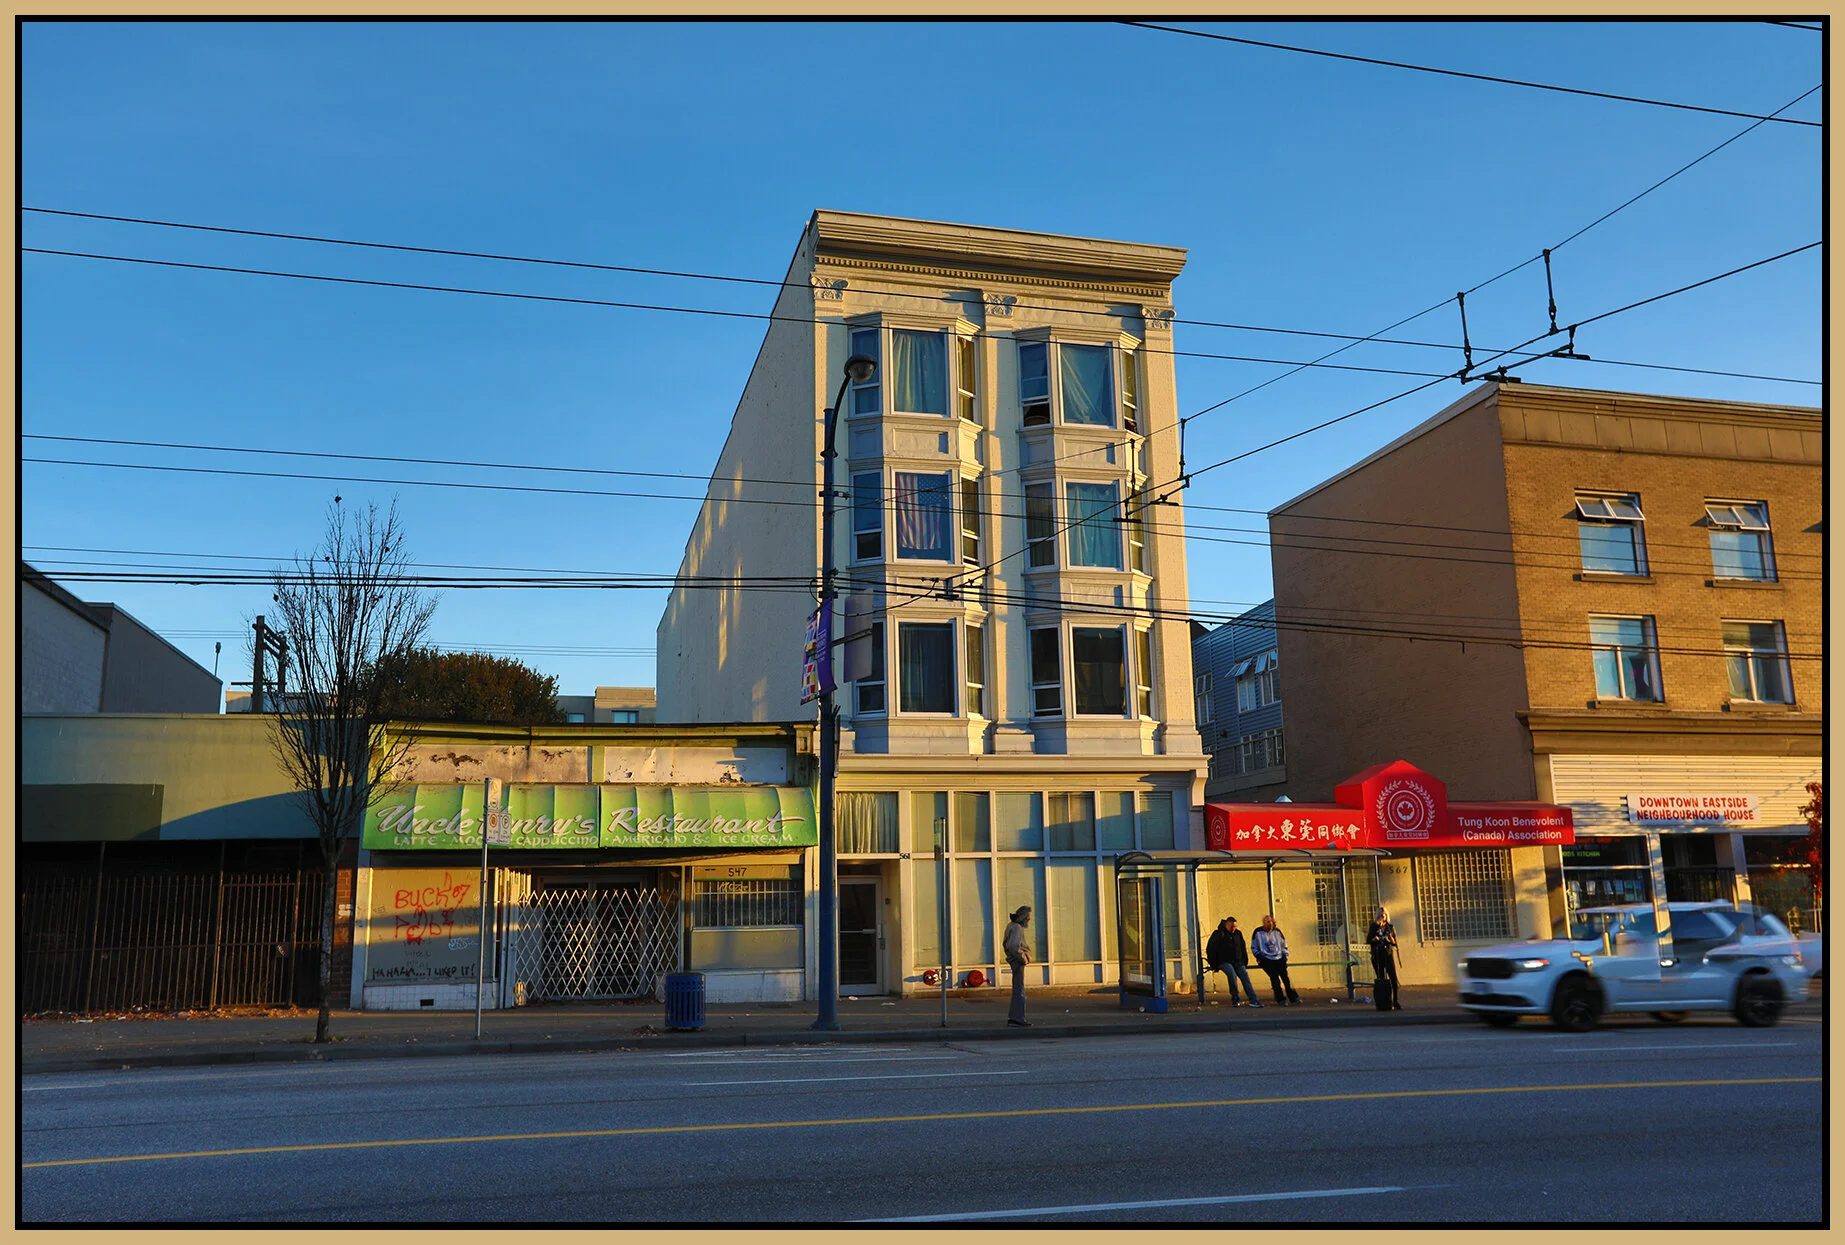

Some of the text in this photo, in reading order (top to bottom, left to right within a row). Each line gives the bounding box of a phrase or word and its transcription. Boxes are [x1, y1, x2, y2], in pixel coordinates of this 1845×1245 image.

[1639, 797, 1748, 808] DOWNTOWN EASTSIDE
[1636, 809, 1755, 821] NEIGHBOURHOOD HOUSE
[376, 805, 475, 836] Uncle
[477, 805, 596, 838] nry's
[607, 807, 806, 835] Restaurant
[1457, 816, 1564, 829] Tung Koon Benevolent
[393, 836, 440, 846] LATTE
[449, 836, 483, 846] MOC
[719, 834, 739, 844] ICE
[741, 834, 793, 846] CREAM
[1462, 829, 1562, 842] (Canada) Association
[728, 867, 748, 877] 547
[1388, 866, 1408, 874] 567
